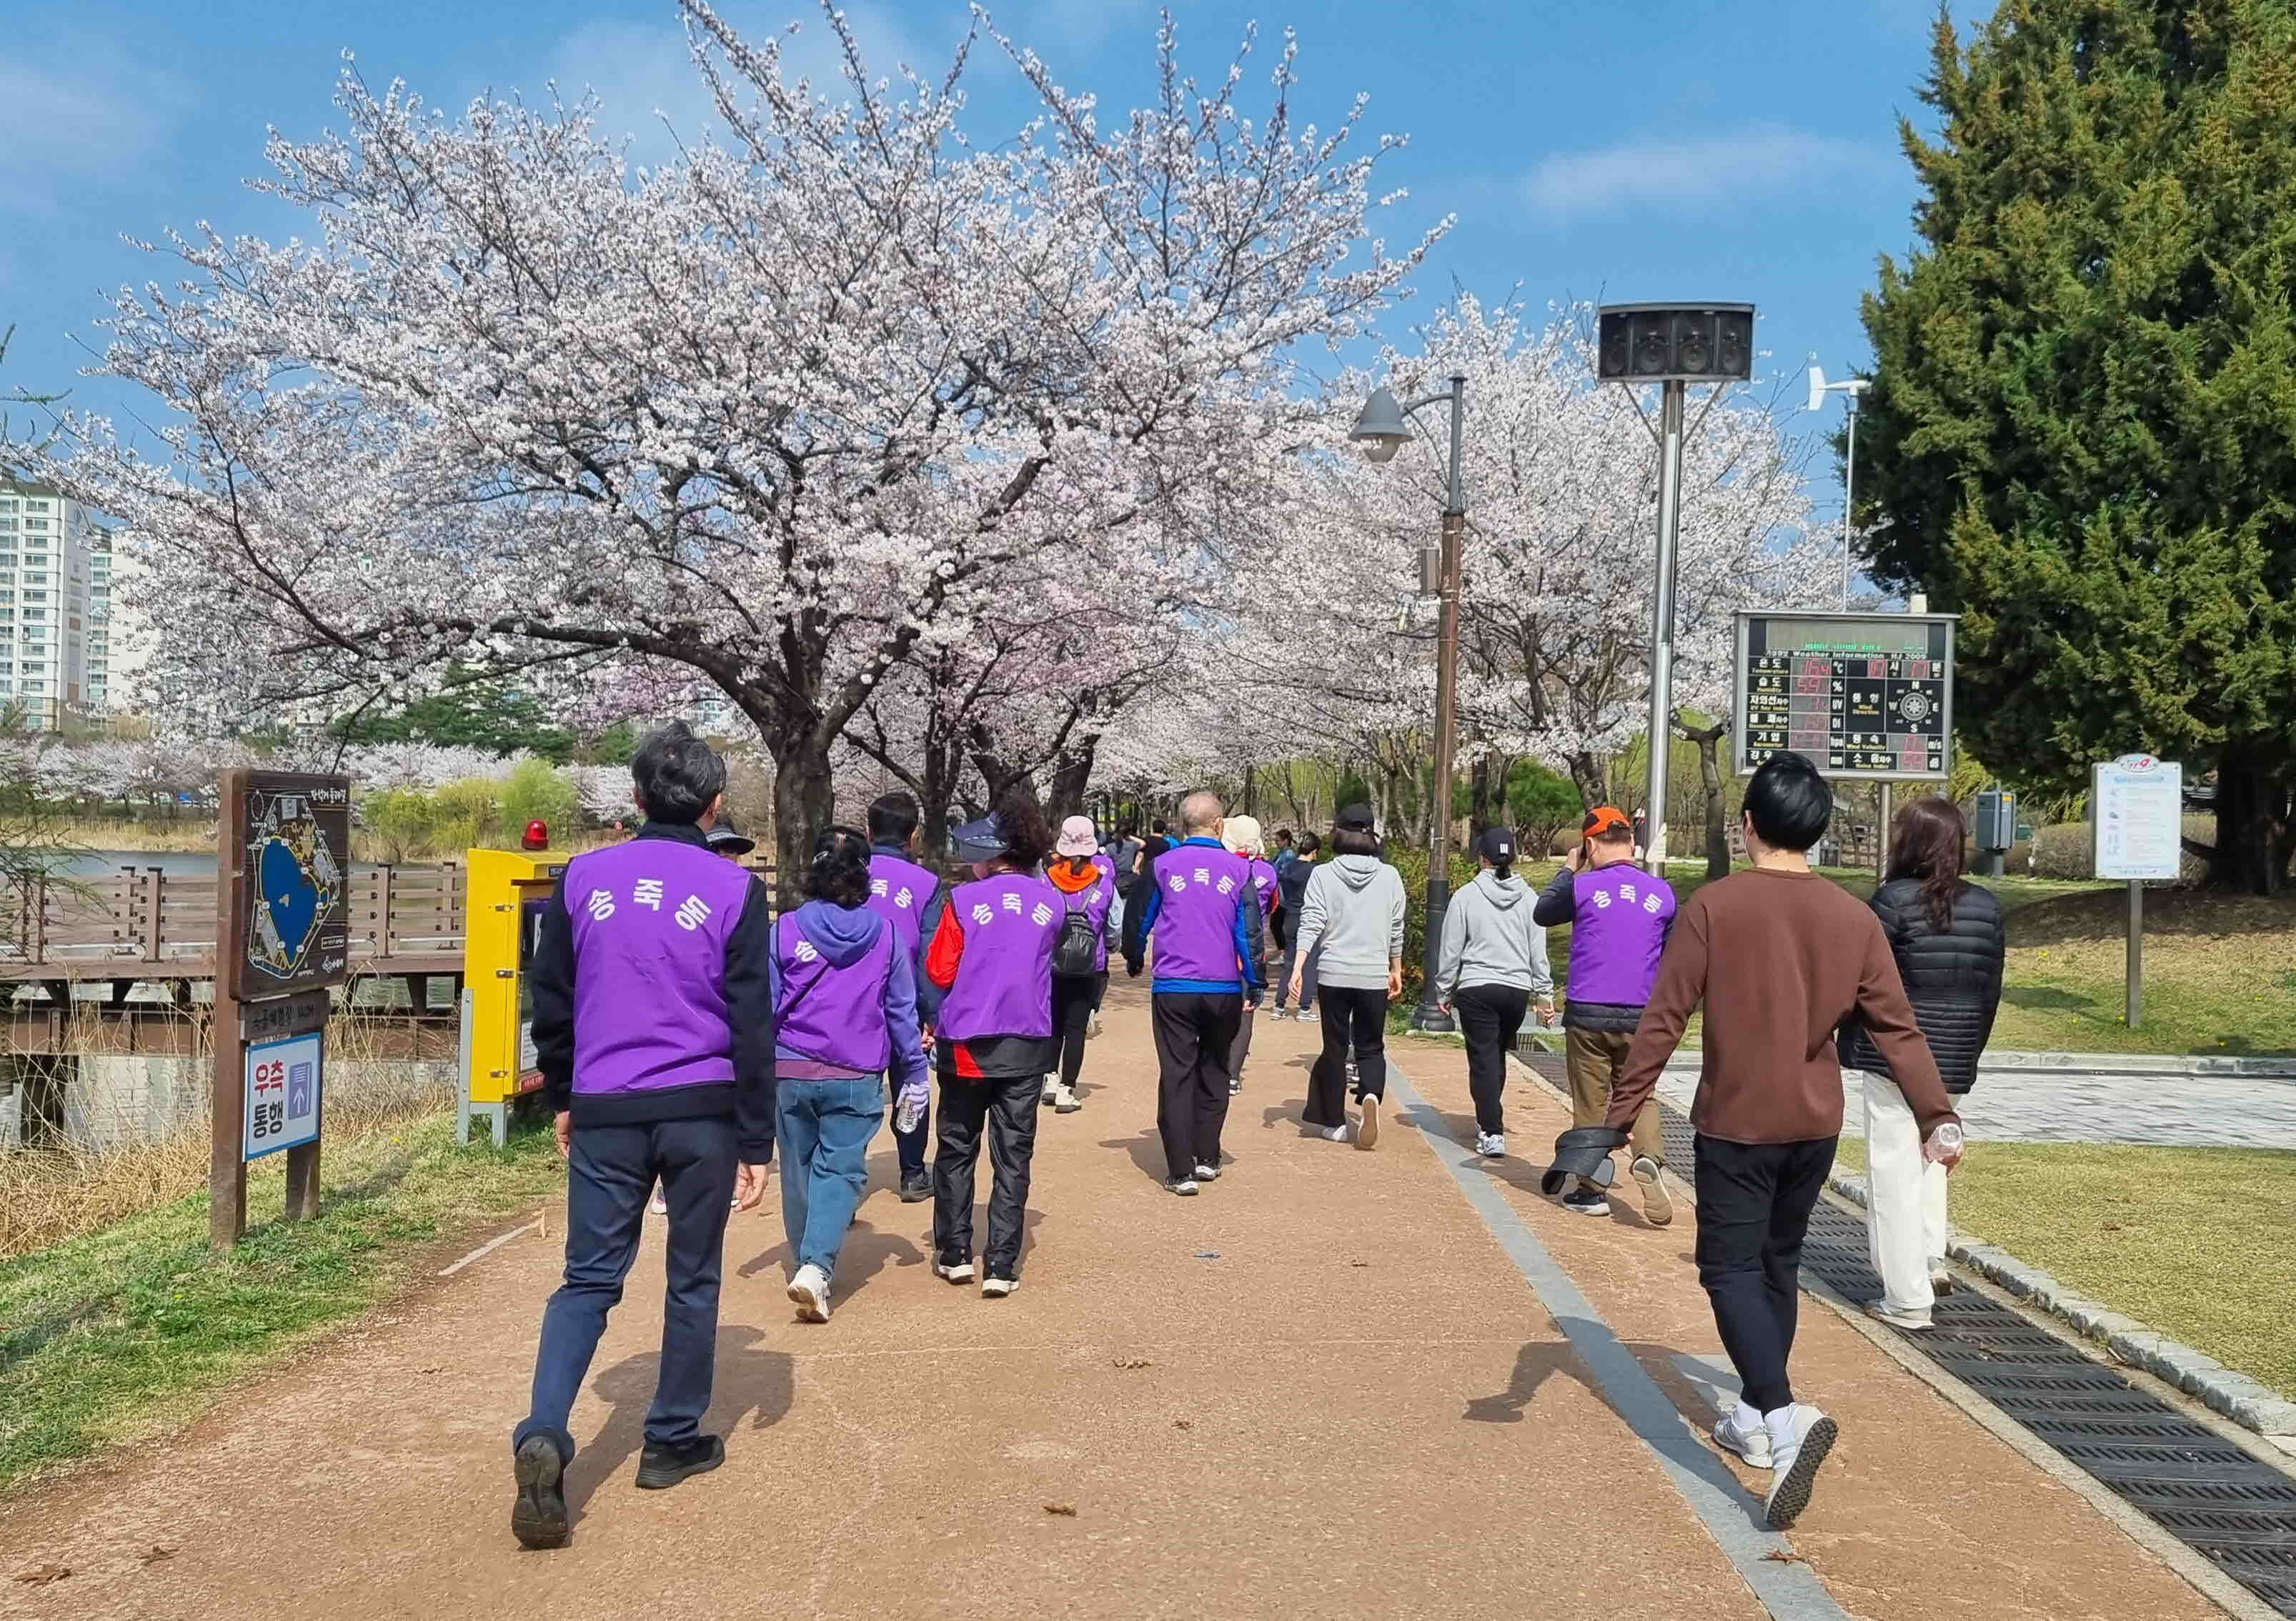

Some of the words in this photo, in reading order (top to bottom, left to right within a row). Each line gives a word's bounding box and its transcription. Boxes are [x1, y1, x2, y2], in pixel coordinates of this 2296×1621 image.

[1759, 658, 1781, 669] 온도
[1889, 661, 1899, 671] 시
[1759, 677, 1781, 688] 습도
[1832, 680, 1843, 692] %
[1912, 681, 1920, 690] N
[1750, 695, 1789, 705] 자외선지수
[1832, 699, 1843, 710] UV
[1888, 701, 1898, 711] W
[1932, 702, 1939, 712] E
[1910, 723, 1918, 733] S
[1757, 732, 1780, 742] 기압
[1927, 739, 1942, 750] m/s
[1168, 867, 1236, 895] 송죽동
[870, 878, 913, 909] 죽동
[1592, 883, 1663, 913] 송죽동
[587, 877, 712, 932] 송죽동
[971, 893, 1054, 926] 송죽동
[254, 1059, 285, 1098] 우측
[253, 1100, 284, 1139] 통행
